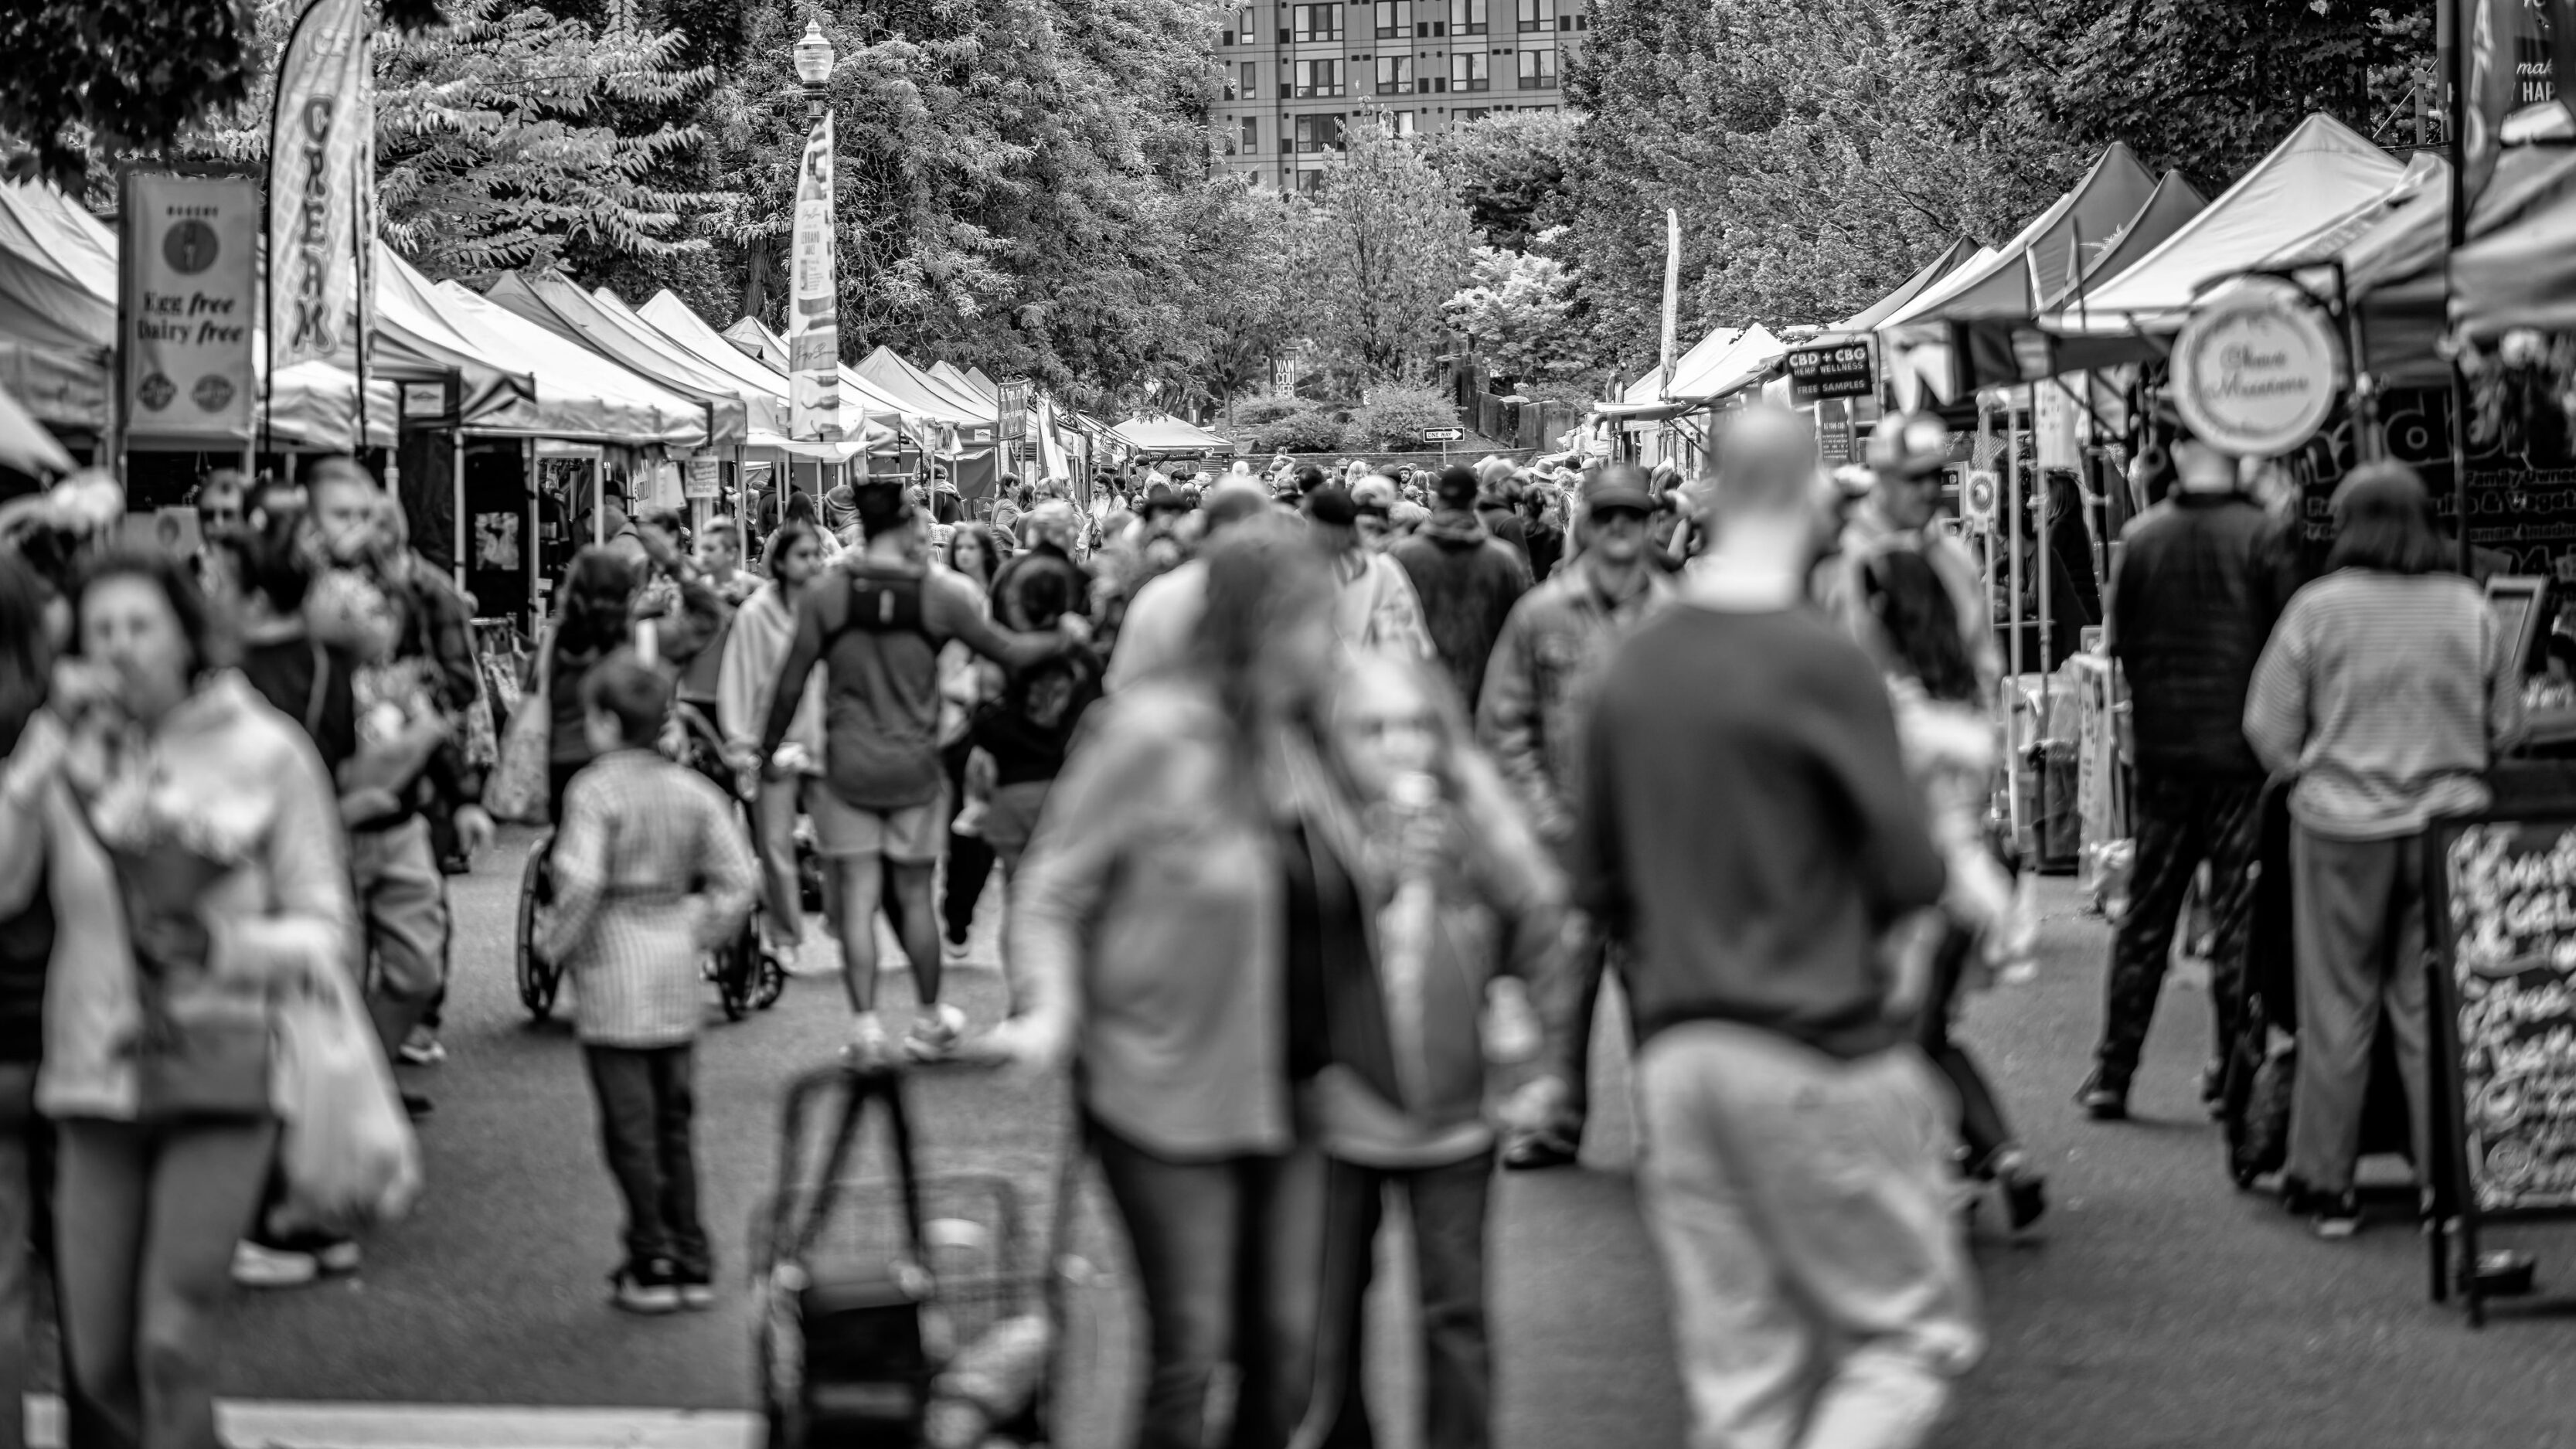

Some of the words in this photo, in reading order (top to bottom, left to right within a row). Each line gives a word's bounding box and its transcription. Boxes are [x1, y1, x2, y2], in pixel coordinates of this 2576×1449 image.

[2523, 80, 2555, 102] HAP
[291, 94, 335, 352] CREAM
[144, 291, 183, 317] Egg
[188, 290, 235, 318] free
[137, 319, 192, 345] Dairy
[196, 319, 244, 345] free
[1275, 359, 1295, 372] VAN
[1788, 353, 1818, 367] CBD
[1822, 352, 1831, 362] +
[1835, 348, 1866, 362] CBG
[1275, 372, 1295, 385] COU
[1794, 367, 1815, 376] HEMP
[1819, 362, 1863, 373] WELLNESS
[1797, 385, 1818, 395] FREE
[1822, 379, 1865, 392] SAMPLES
[2505, 490, 2576, 514] Veget
